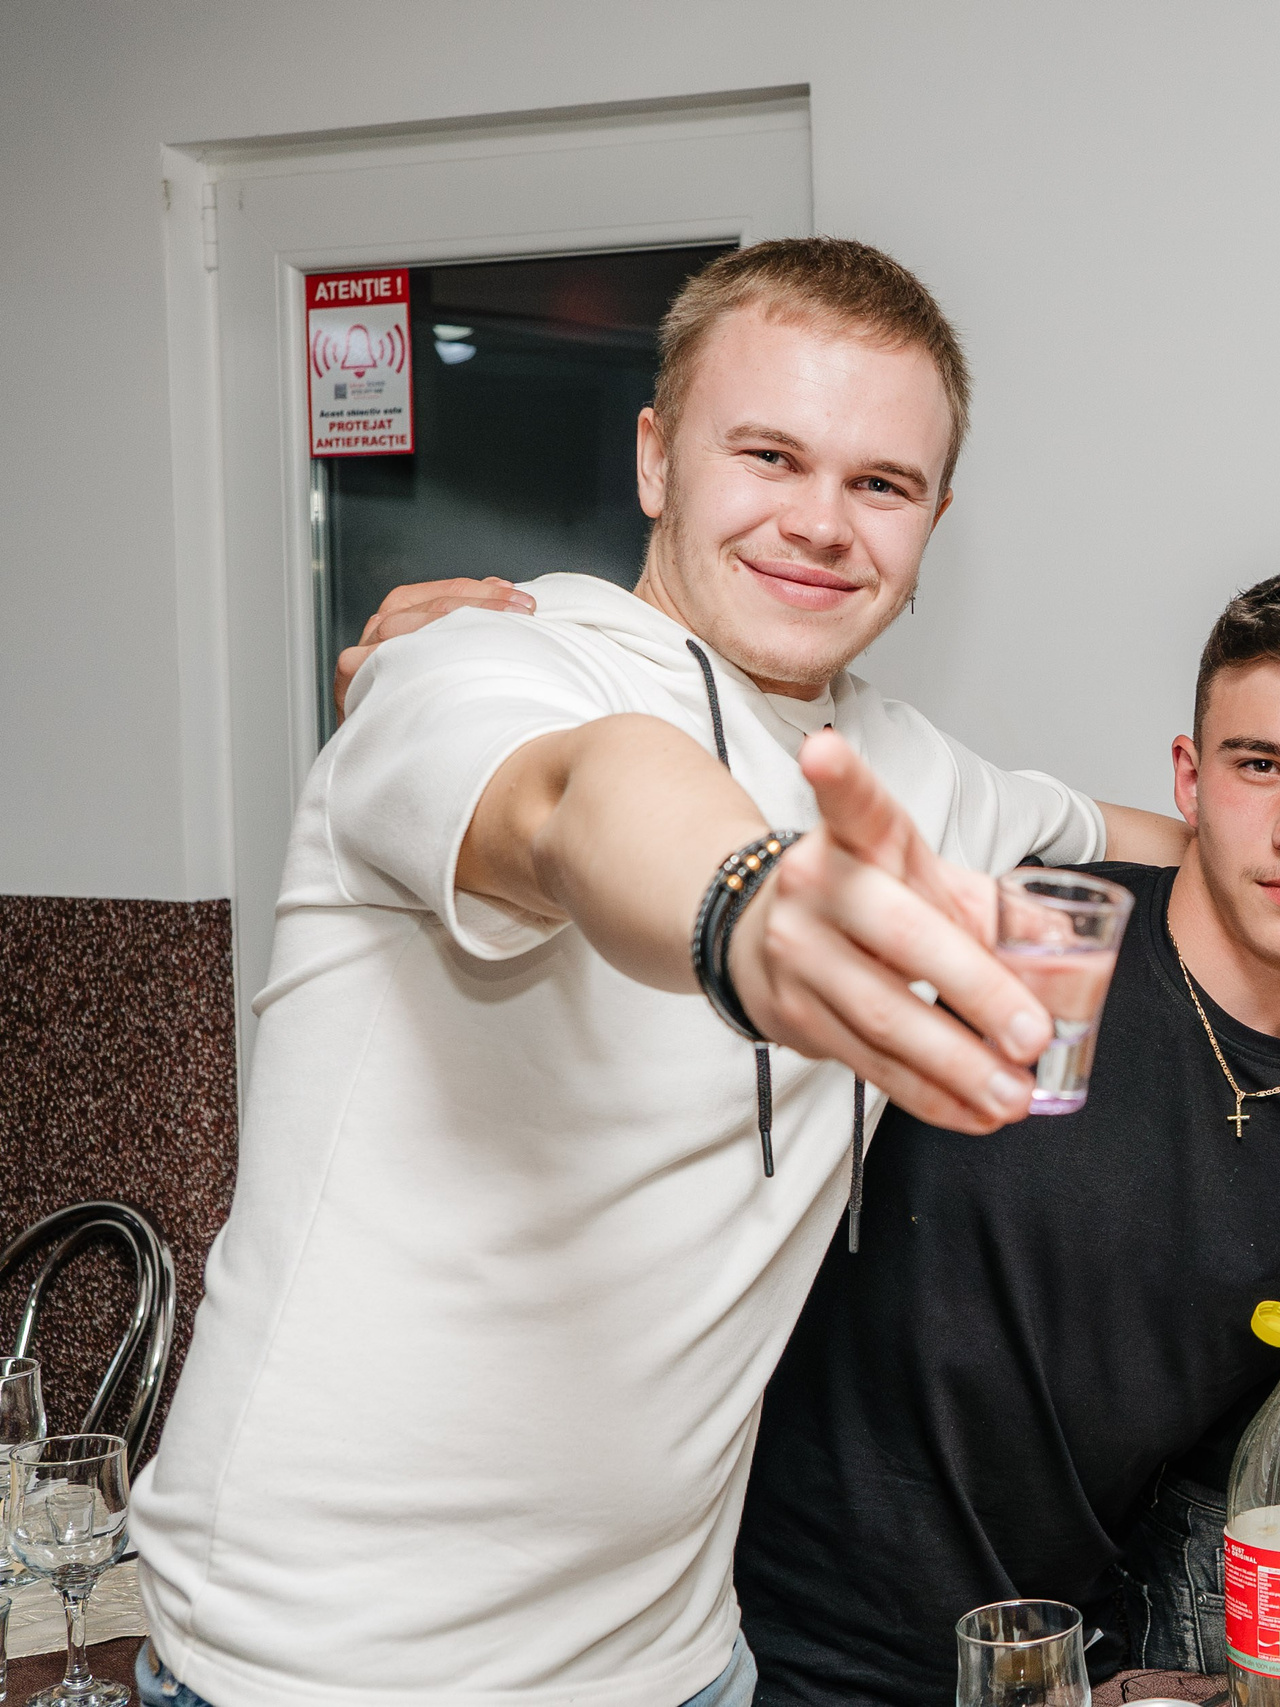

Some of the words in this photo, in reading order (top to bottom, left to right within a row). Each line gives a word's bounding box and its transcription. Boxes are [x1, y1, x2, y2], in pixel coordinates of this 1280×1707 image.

[396, 276, 403, 296] !
[319, 409, 344, 418] Acest
[329, 419, 393, 432] PROTEJAT
[1231, 1544, 1245, 1554] GUST
[1231, 1551, 1257, 1564] ORIGINAL
